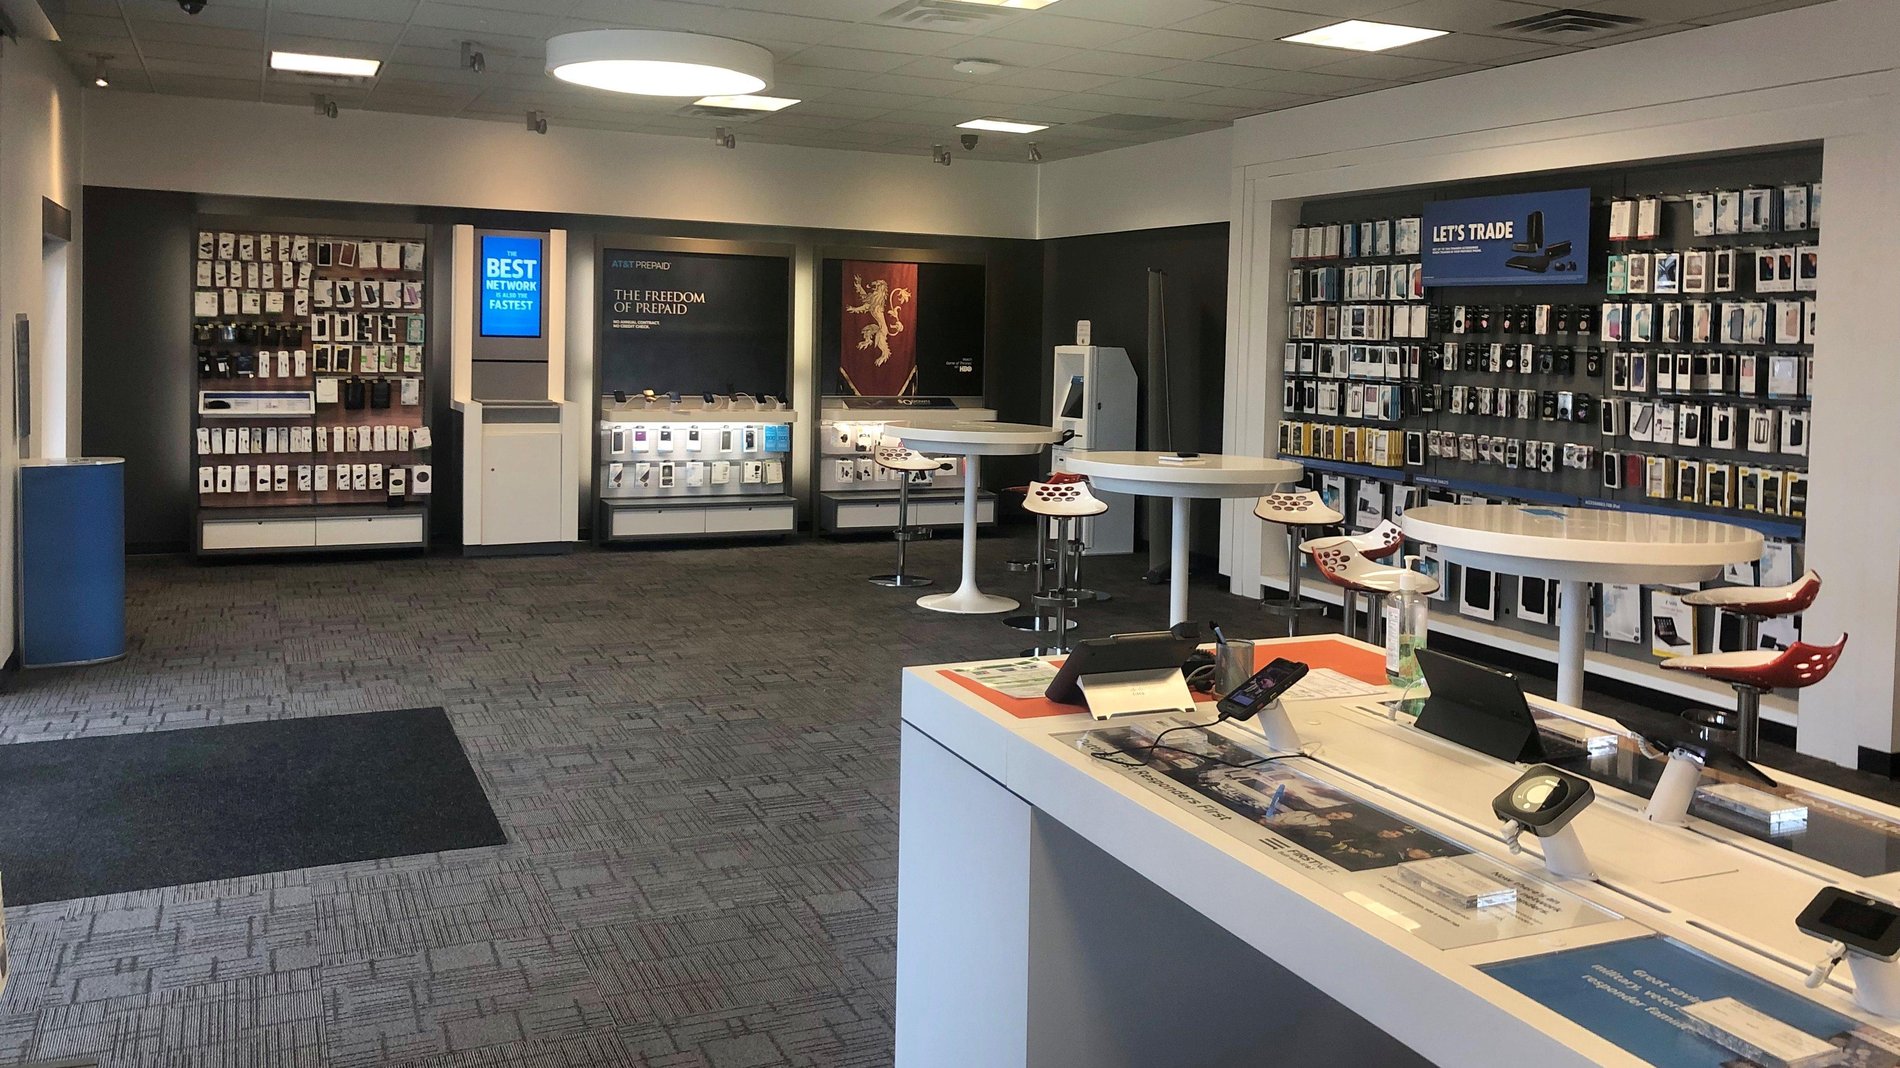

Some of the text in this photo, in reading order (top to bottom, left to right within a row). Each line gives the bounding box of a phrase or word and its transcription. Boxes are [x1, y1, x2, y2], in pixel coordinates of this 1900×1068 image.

[1432, 221, 1514, 243] LET'S TRADE
[486, 257, 538, 279] BEST
[611, 260, 672, 270] AT&T PREPAID
[486, 279, 537, 291] NETWORK
[489, 299, 534, 311] FASTEST
[614, 289, 706, 303] THE FREEDOM
[613, 301, 688, 315] OF PREPAID
[1134, 769, 1202, 807] Responders
[1197, 803, 1233, 822] First
[1492, 871, 1512, 884] Now
[1519, 892, 1563, 913] network
[1591, 963, 1643, 991] military,
[1632, 968, 1670, 988] Great
[1581, 974, 1647, 1007] responder
